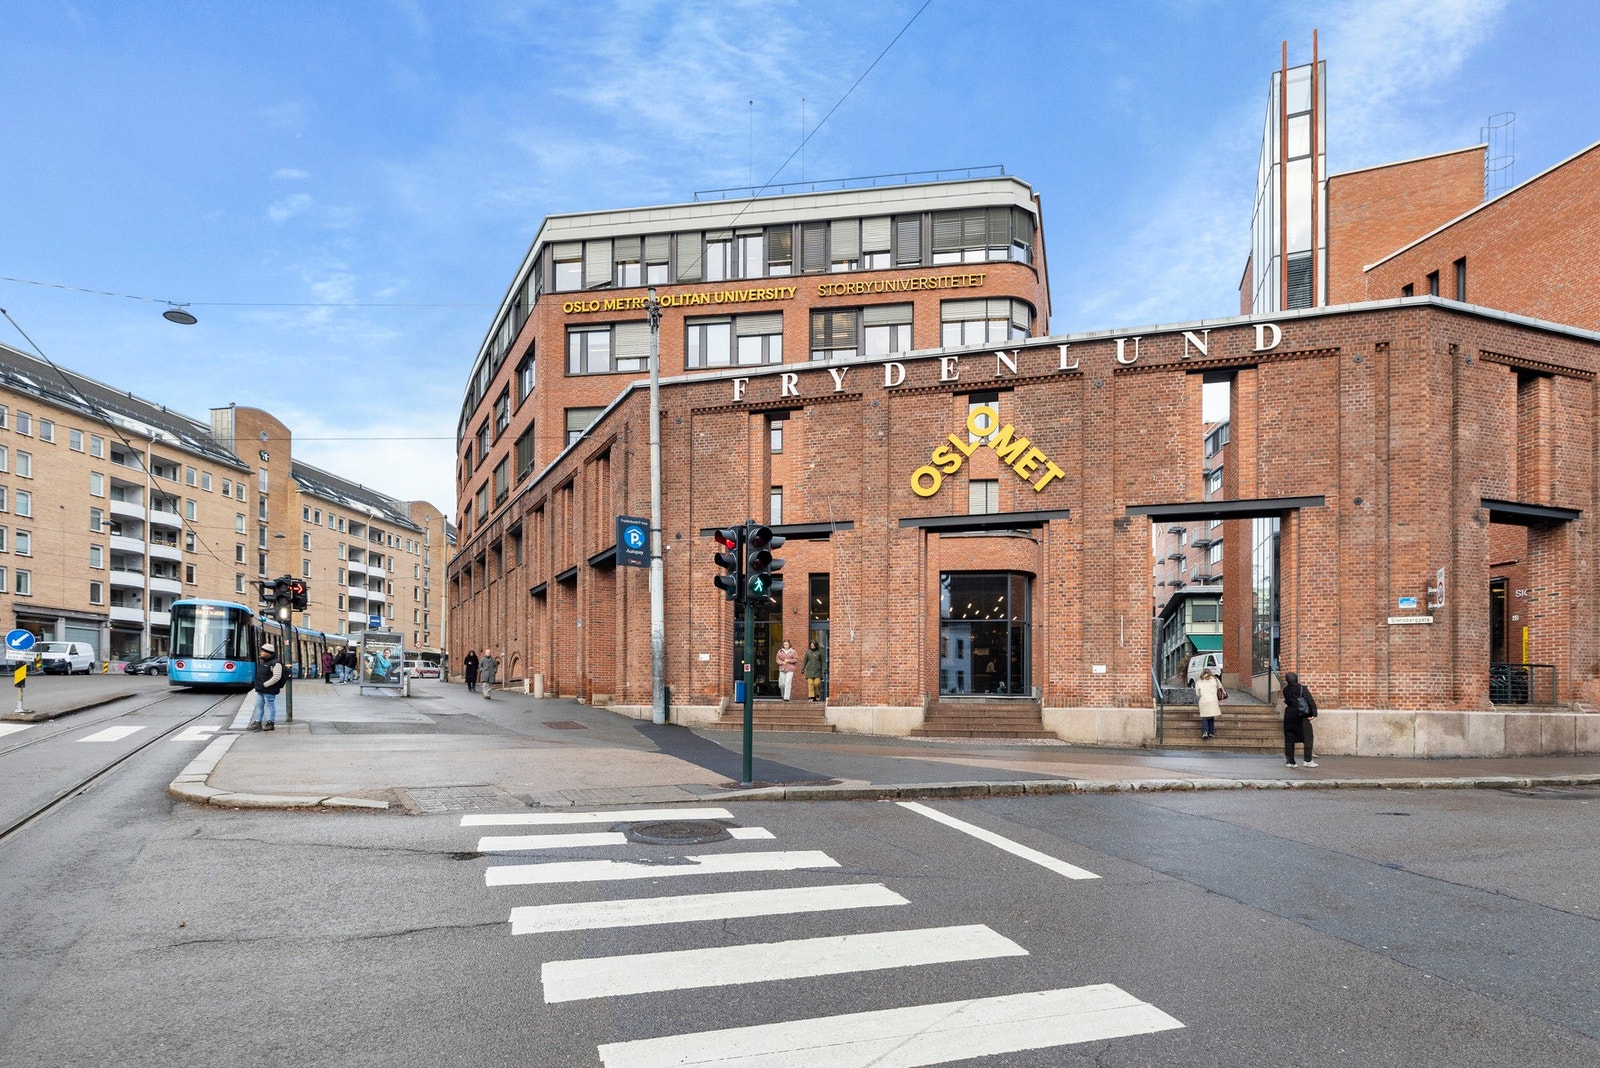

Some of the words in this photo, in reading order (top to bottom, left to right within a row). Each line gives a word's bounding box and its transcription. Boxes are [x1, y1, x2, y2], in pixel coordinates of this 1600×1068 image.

[562, 300, 600, 314] OSLO
[714, 286, 798, 303] UNIVERSITY
[817, 274, 986, 297] STORBYUNIVERSITETET
[732, 323, 1282, 402] FRYDENLUND
[911, 406, 1066, 497] OSLOMET
